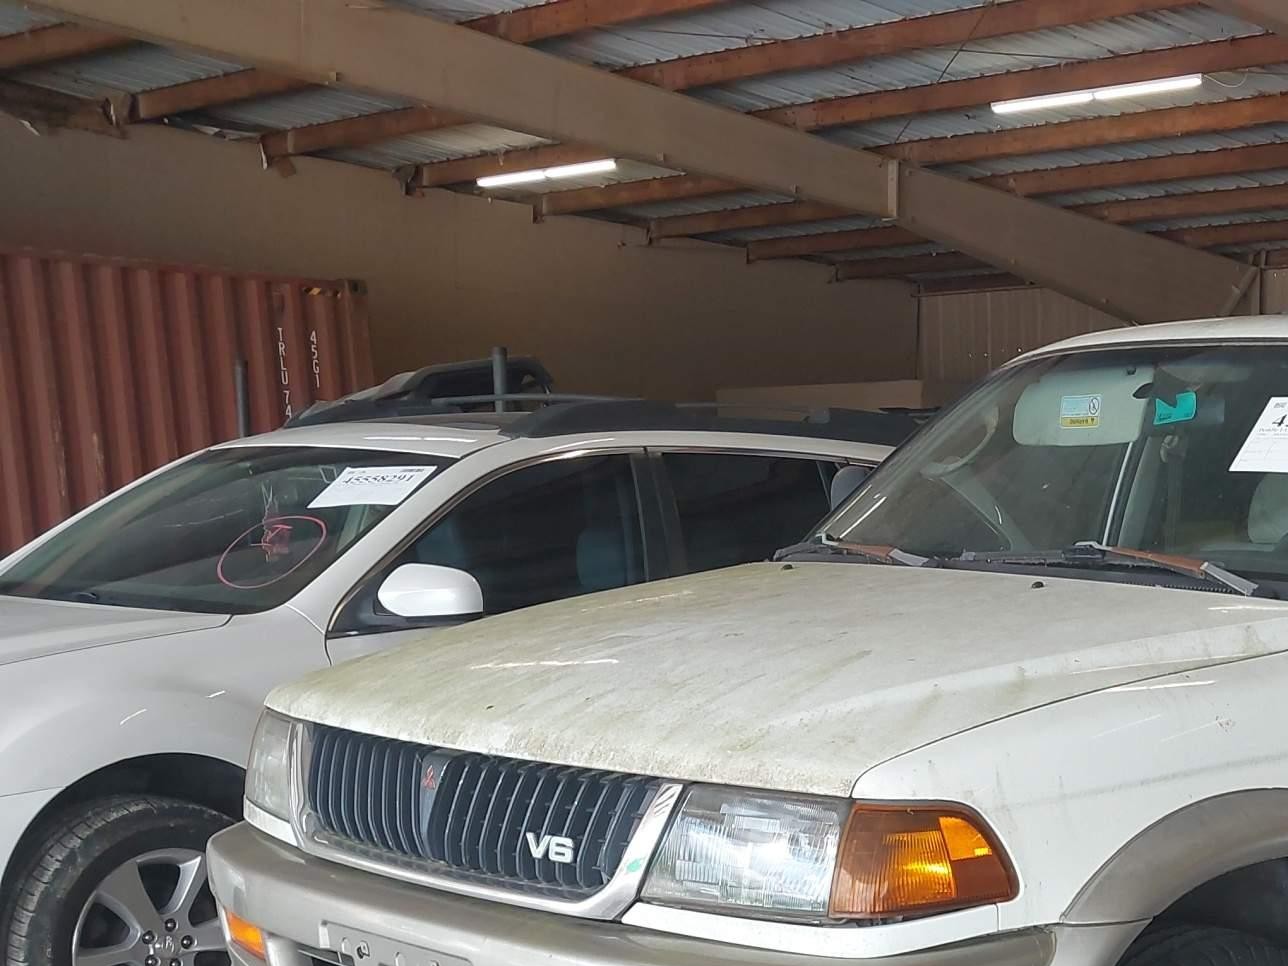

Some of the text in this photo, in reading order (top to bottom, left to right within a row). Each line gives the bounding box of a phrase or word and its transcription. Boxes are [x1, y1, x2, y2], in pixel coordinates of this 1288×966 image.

[277, 327, 292, 419] TRLU 74
[310, 330, 320, 388] 45G1
[526, 832, 574, 863] V6
